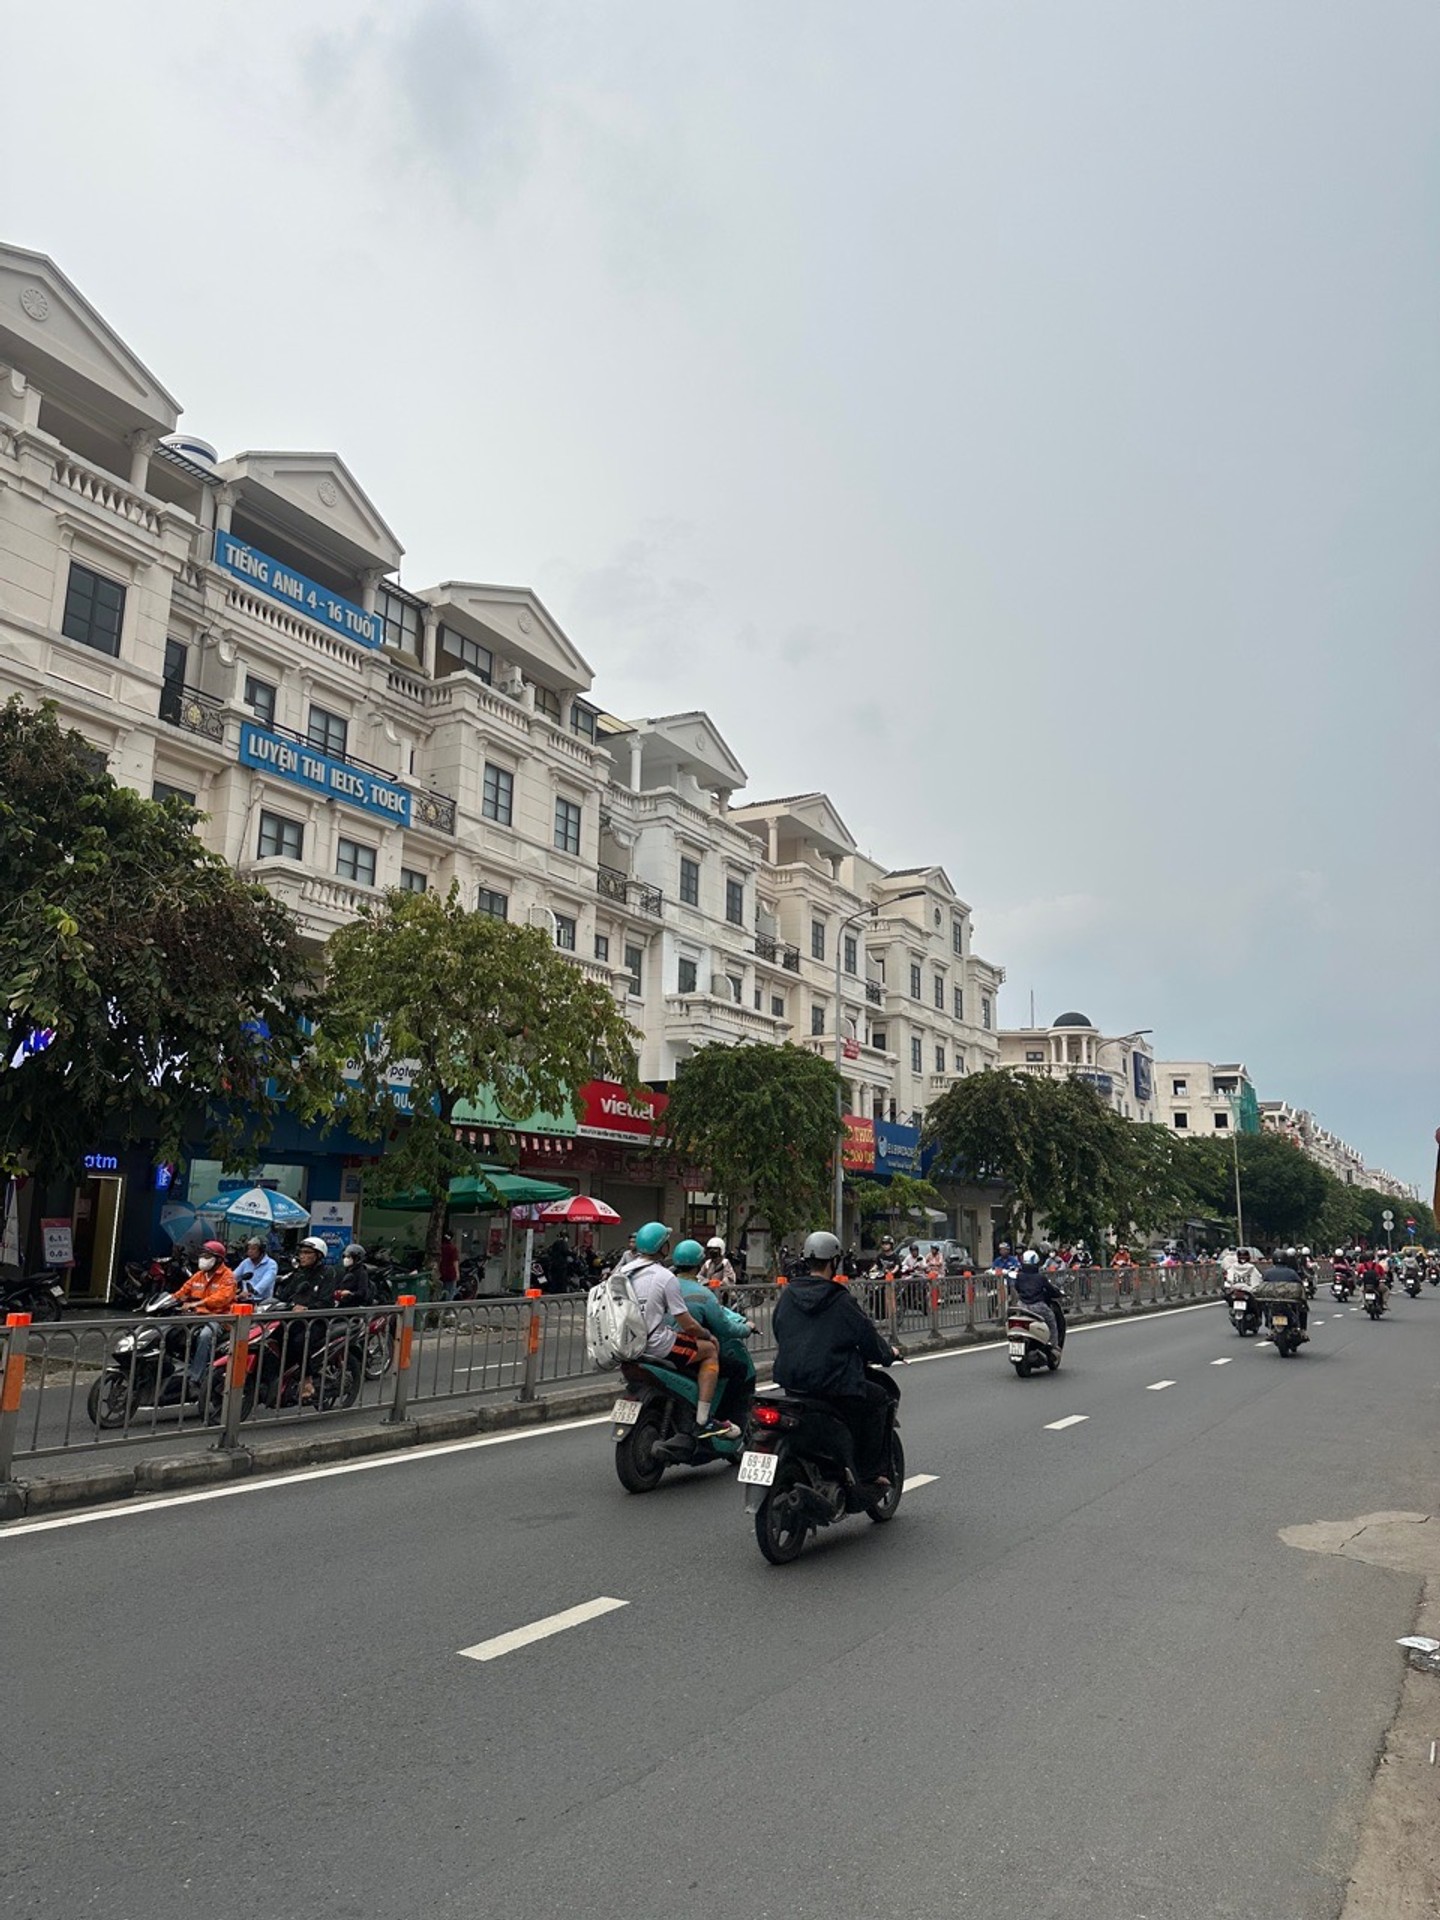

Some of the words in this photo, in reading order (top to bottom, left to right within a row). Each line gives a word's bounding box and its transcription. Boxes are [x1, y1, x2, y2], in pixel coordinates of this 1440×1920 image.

[224, 542, 269, 583] TIẾNG
[272, 570, 304, 602] ANH
[307, 590, 317, 610] 4
[327, 601, 342, 623] 16
[345, 609, 375, 641] TUỔI
[248, 733, 298, 772] LUYỆN
[301, 755, 326, 783] THI
[330, 767, 369, 804] IELTS,
[371, 783, 406, 815] TOEIC
[84, 1153, 118, 1169] atm
